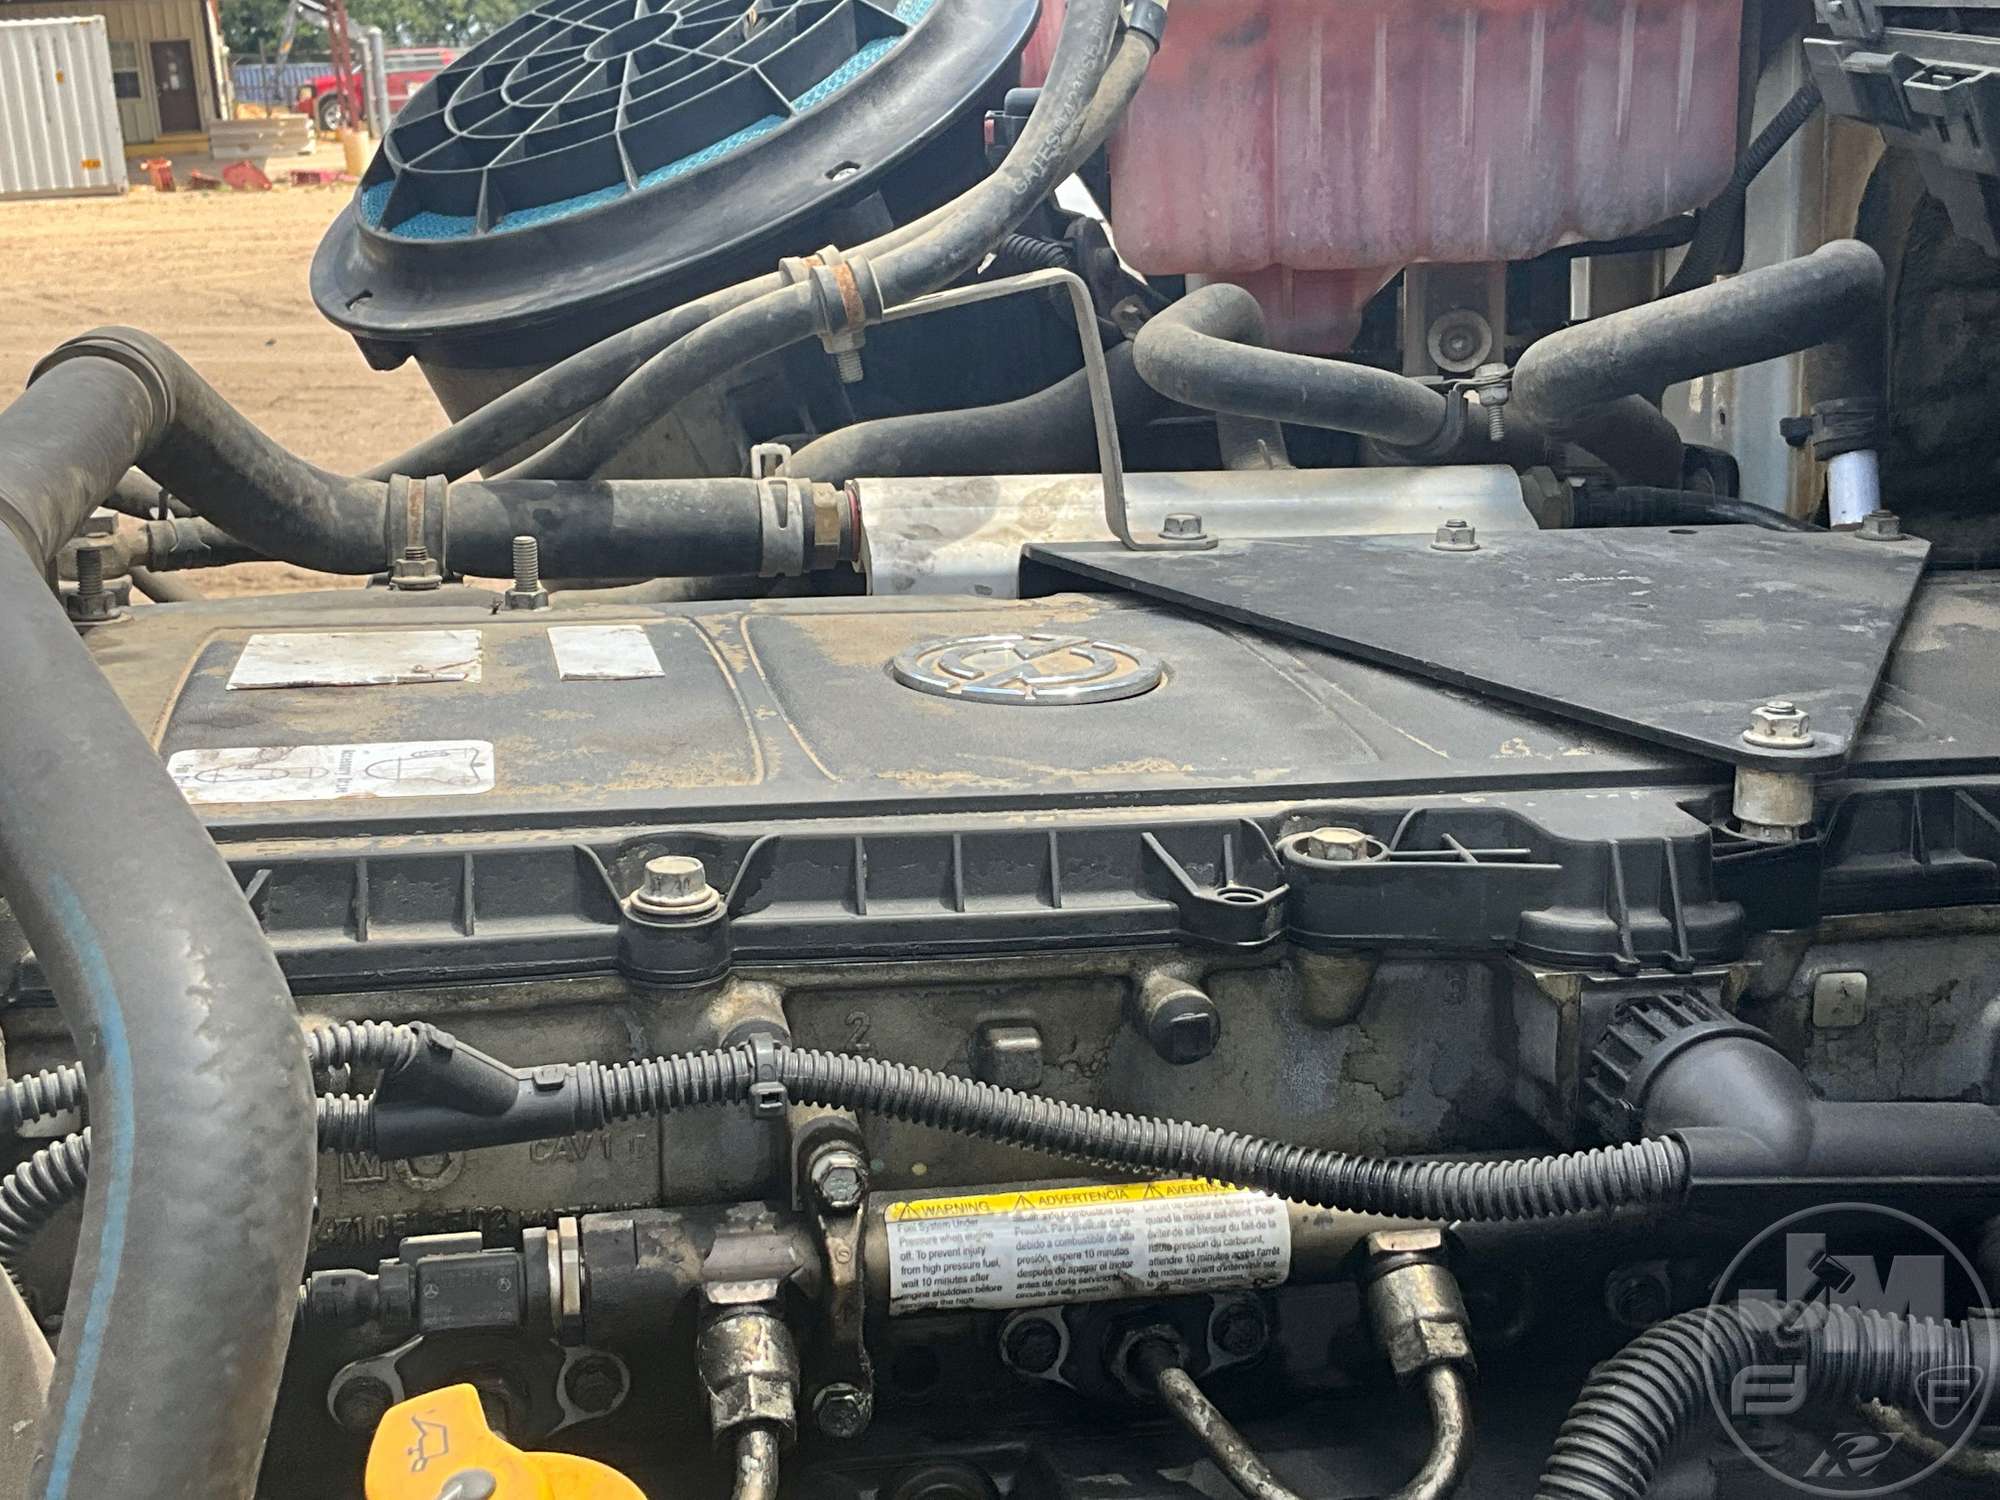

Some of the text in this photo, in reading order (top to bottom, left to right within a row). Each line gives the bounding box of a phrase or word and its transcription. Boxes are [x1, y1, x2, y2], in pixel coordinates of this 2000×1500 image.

[842, 1006, 872, 1049] 2
[1039, 1189, 1129, 1206] ADVERTENCIA
[922, 1201, 990, 1216] WARNING
[1016, 1240, 1045, 1250] debido
[1085, 1249, 1095, 1258] 10
[1097, 1247, 1129, 1257] minutos
[1174, 1239, 1209, 1253] pression
[1211, 1237, 1222, 1248] du
[917, 1251, 927, 1260] To
[929, 1248, 961, 1261] prevent
[963, 1246, 986, 1257] injury
[1149, 1255, 1182, 1266] attendre
[1185, 1253, 1195, 1263] 10
[1198, 1251, 1230, 1263] minutes
[901, 1265, 921, 1275] from
[923, 1263, 941, 1275] high
[943, 1261, 981, 1273] pressure
[1148, 1268, 1159, 1278] du
[1161, 1267, 1189, 1277] moteur
[1192, 1264, 1215, 1274] avant
[901, 1273, 990, 1288] wait 10 minutes after
[932, 1286, 973, 1297] shutdown
